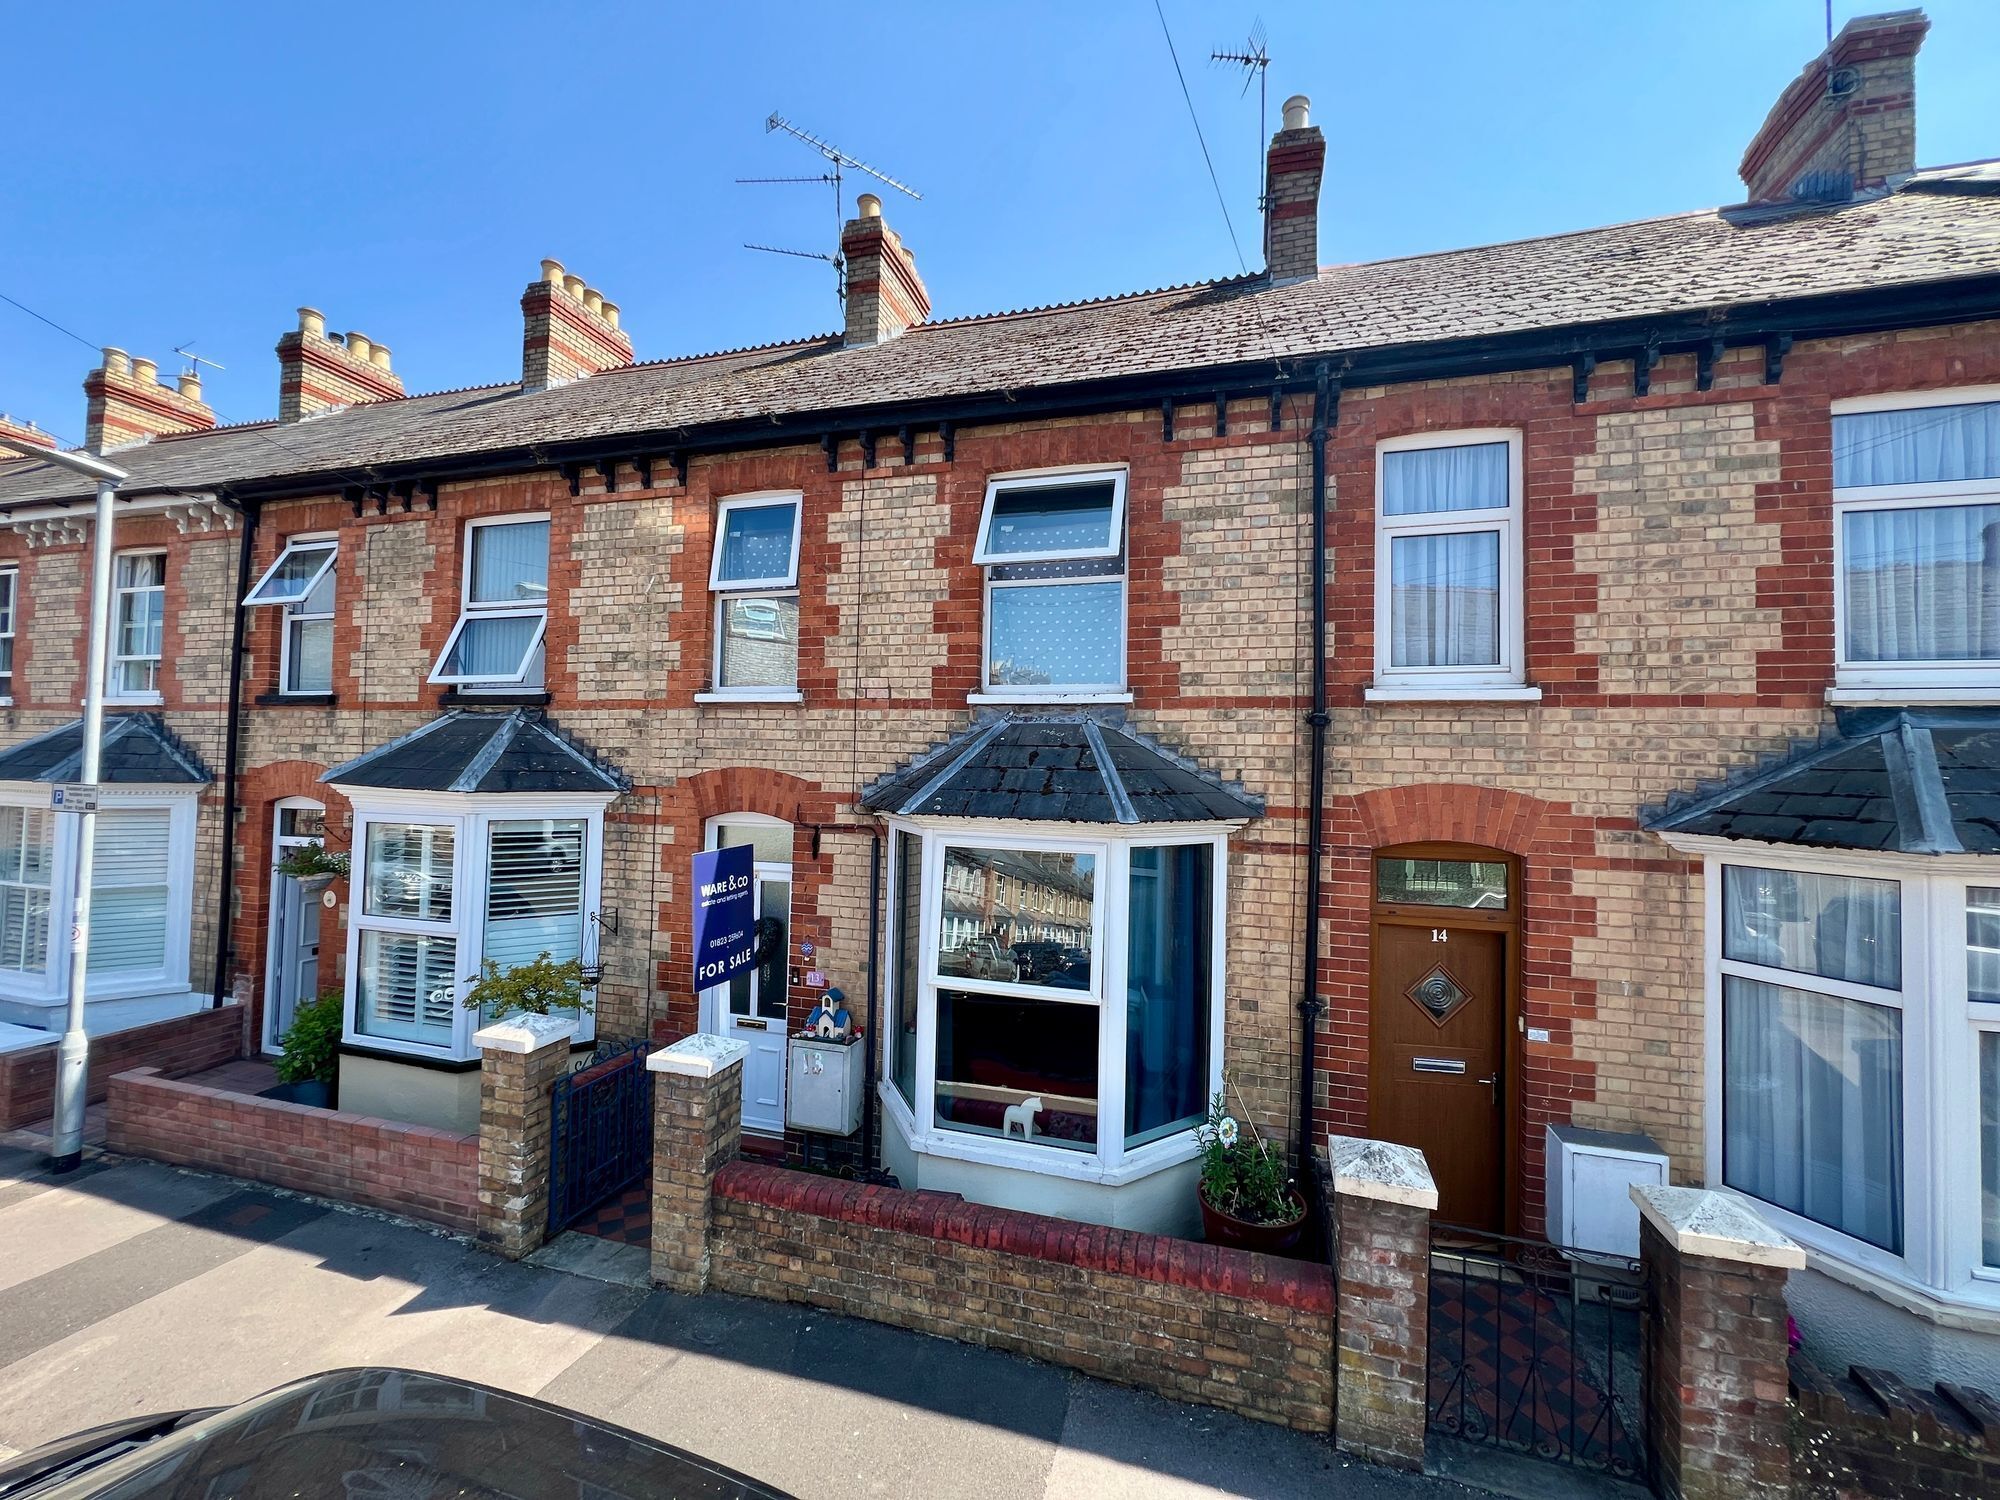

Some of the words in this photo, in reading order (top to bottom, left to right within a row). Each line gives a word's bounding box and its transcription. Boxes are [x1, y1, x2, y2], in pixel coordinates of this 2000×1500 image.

[700, 881, 728, 898] WARE
[728, 874, 737, 891] &
[737, 875, 749, 888] CO
[716, 896, 726, 904] and
[709, 936, 728, 949] 01823
[1431, 929, 1448, 943] 14
[699, 960, 725, 981] FOR
[729, 948, 751, 970] SALE
[810, 973, 820, 982] 13
